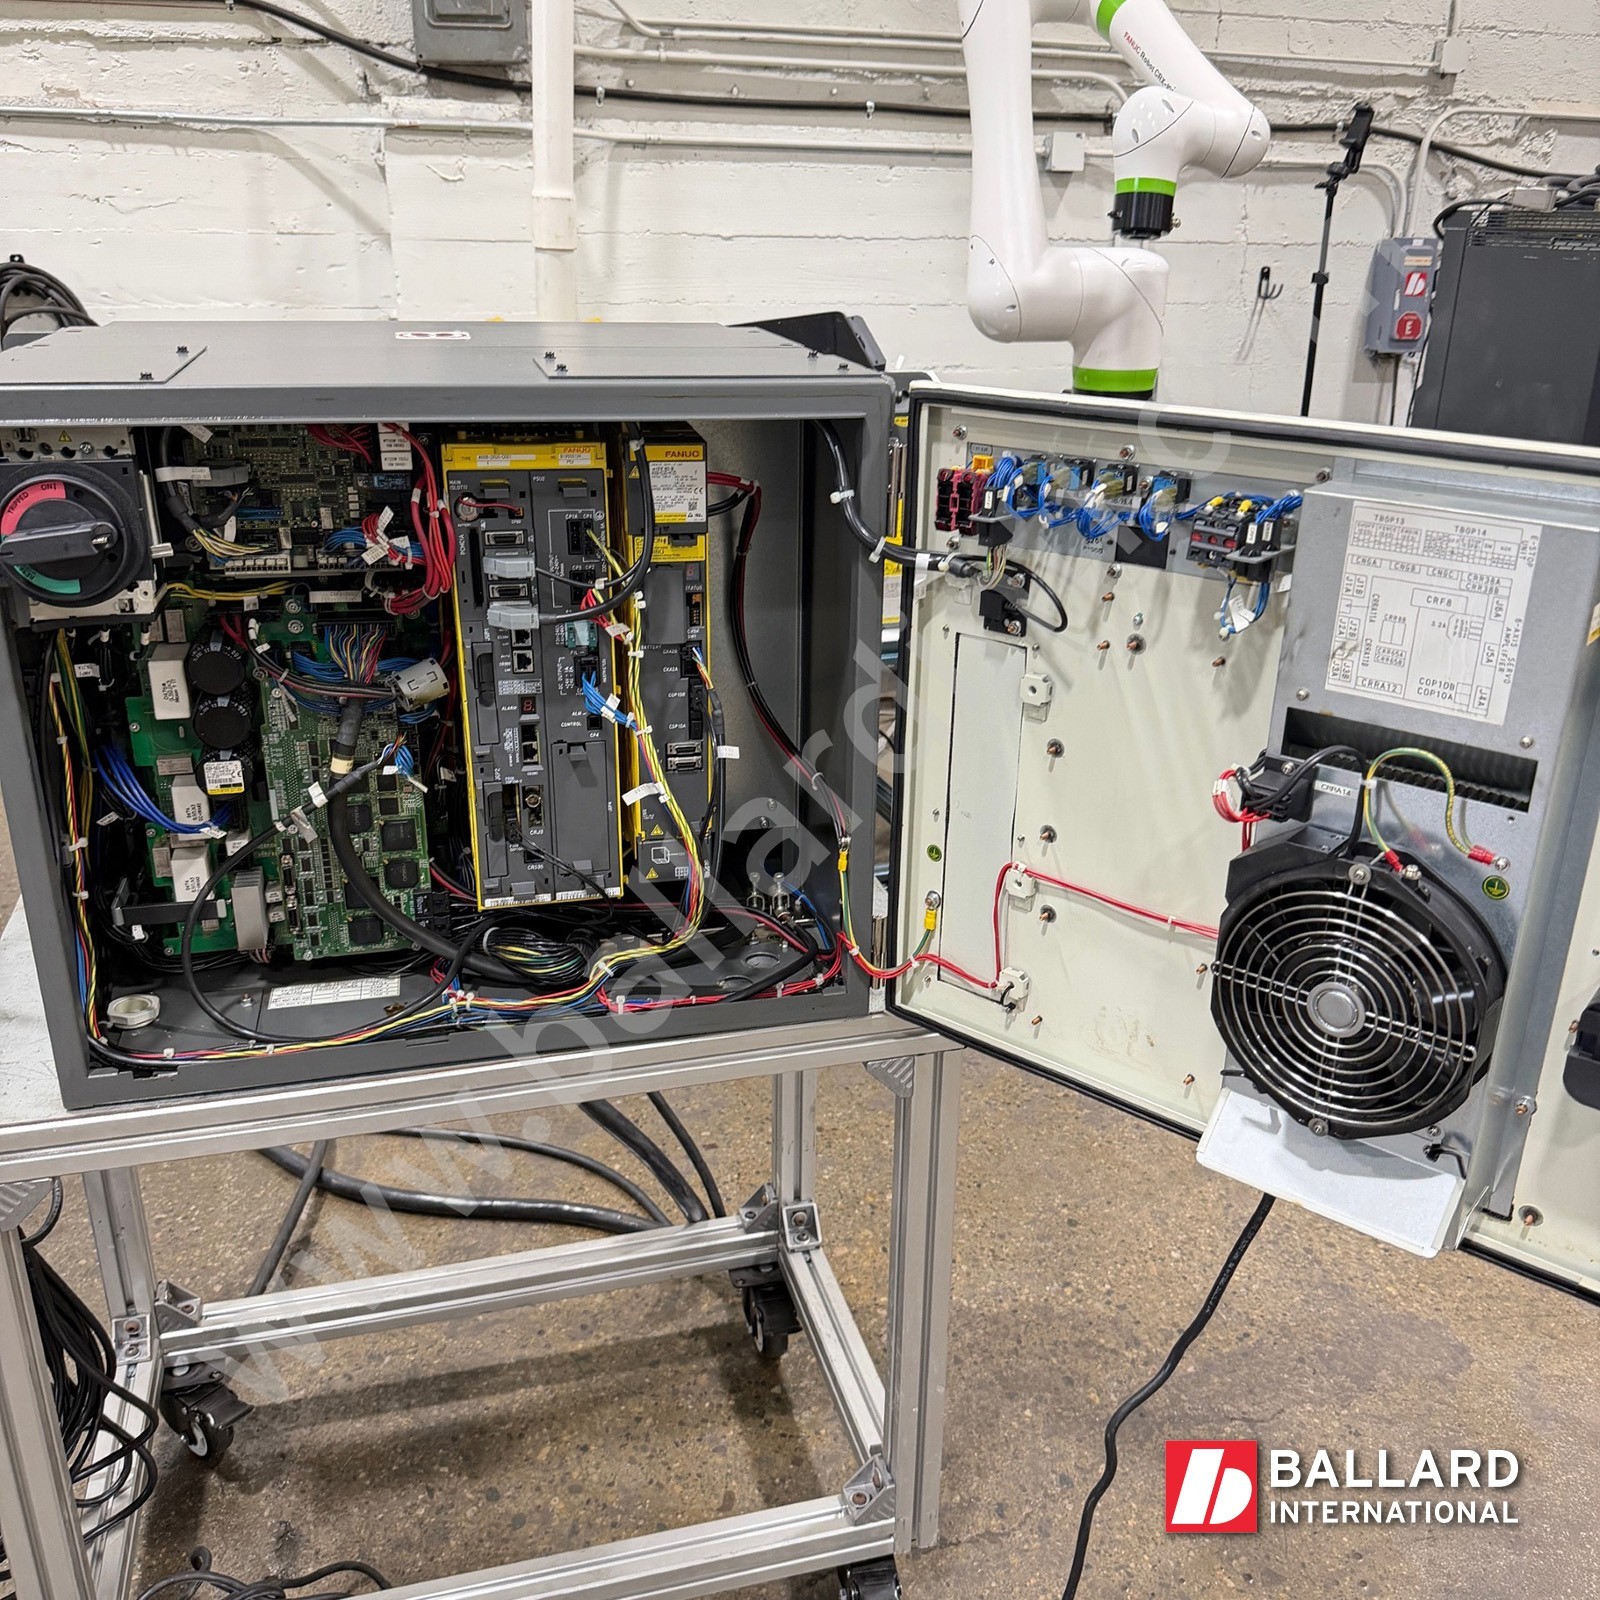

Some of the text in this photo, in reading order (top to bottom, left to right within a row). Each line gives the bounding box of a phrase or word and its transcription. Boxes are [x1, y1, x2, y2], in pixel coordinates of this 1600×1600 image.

[1123, 31, 1141, 54] FANUC
[1140, 51, 1155, 73] Robot
[665, 450, 700, 458] FANUC
[7, 492, 29, 514] TRIPPED
[1520, 540, 1528, 560] UNIT
[1527, 535, 1539, 568] E-STOP
[1498, 626, 1512, 673] AMPLIFIER
[1503, 617, 1523, 685] 6-AXIS SERVO
[1361, 678, 1398, 692] CRRA12
[1417, 687, 1453, 701] COP10A
[1419, 677, 1456, 691] COP10B
[1320, 784, 1352, 798] CRRA14
